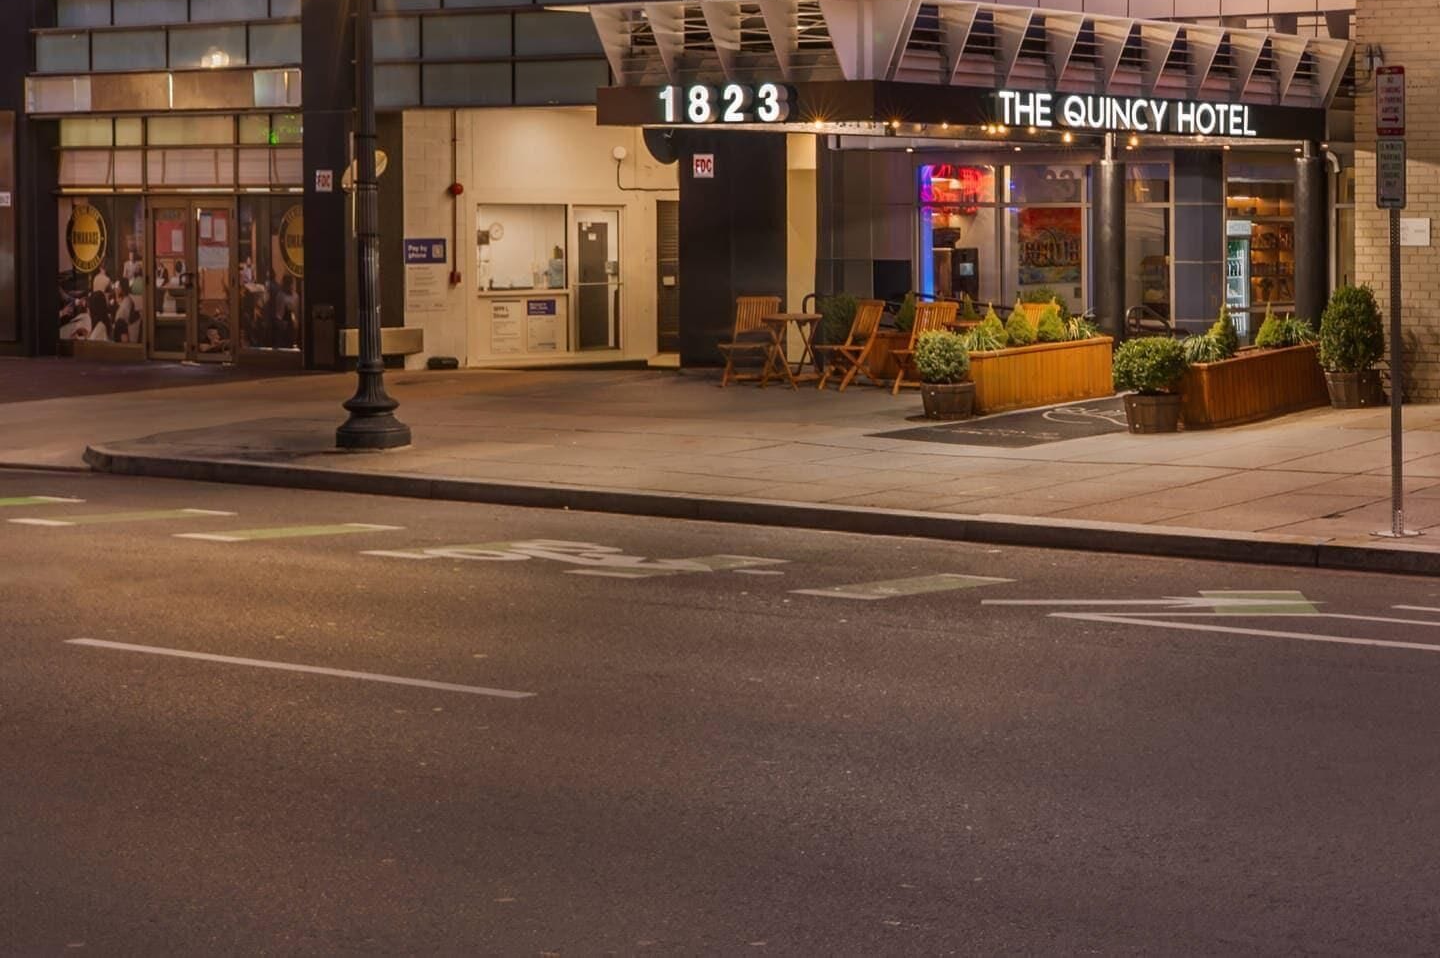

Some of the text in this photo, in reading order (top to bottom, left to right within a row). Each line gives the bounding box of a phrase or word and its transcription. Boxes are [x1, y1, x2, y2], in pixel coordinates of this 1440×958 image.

[659, 83, 781, 123] 1823
[998, 91, 1257, 136] THE QUINCY HOTEL
[694, 159, 713, 174] FDC
